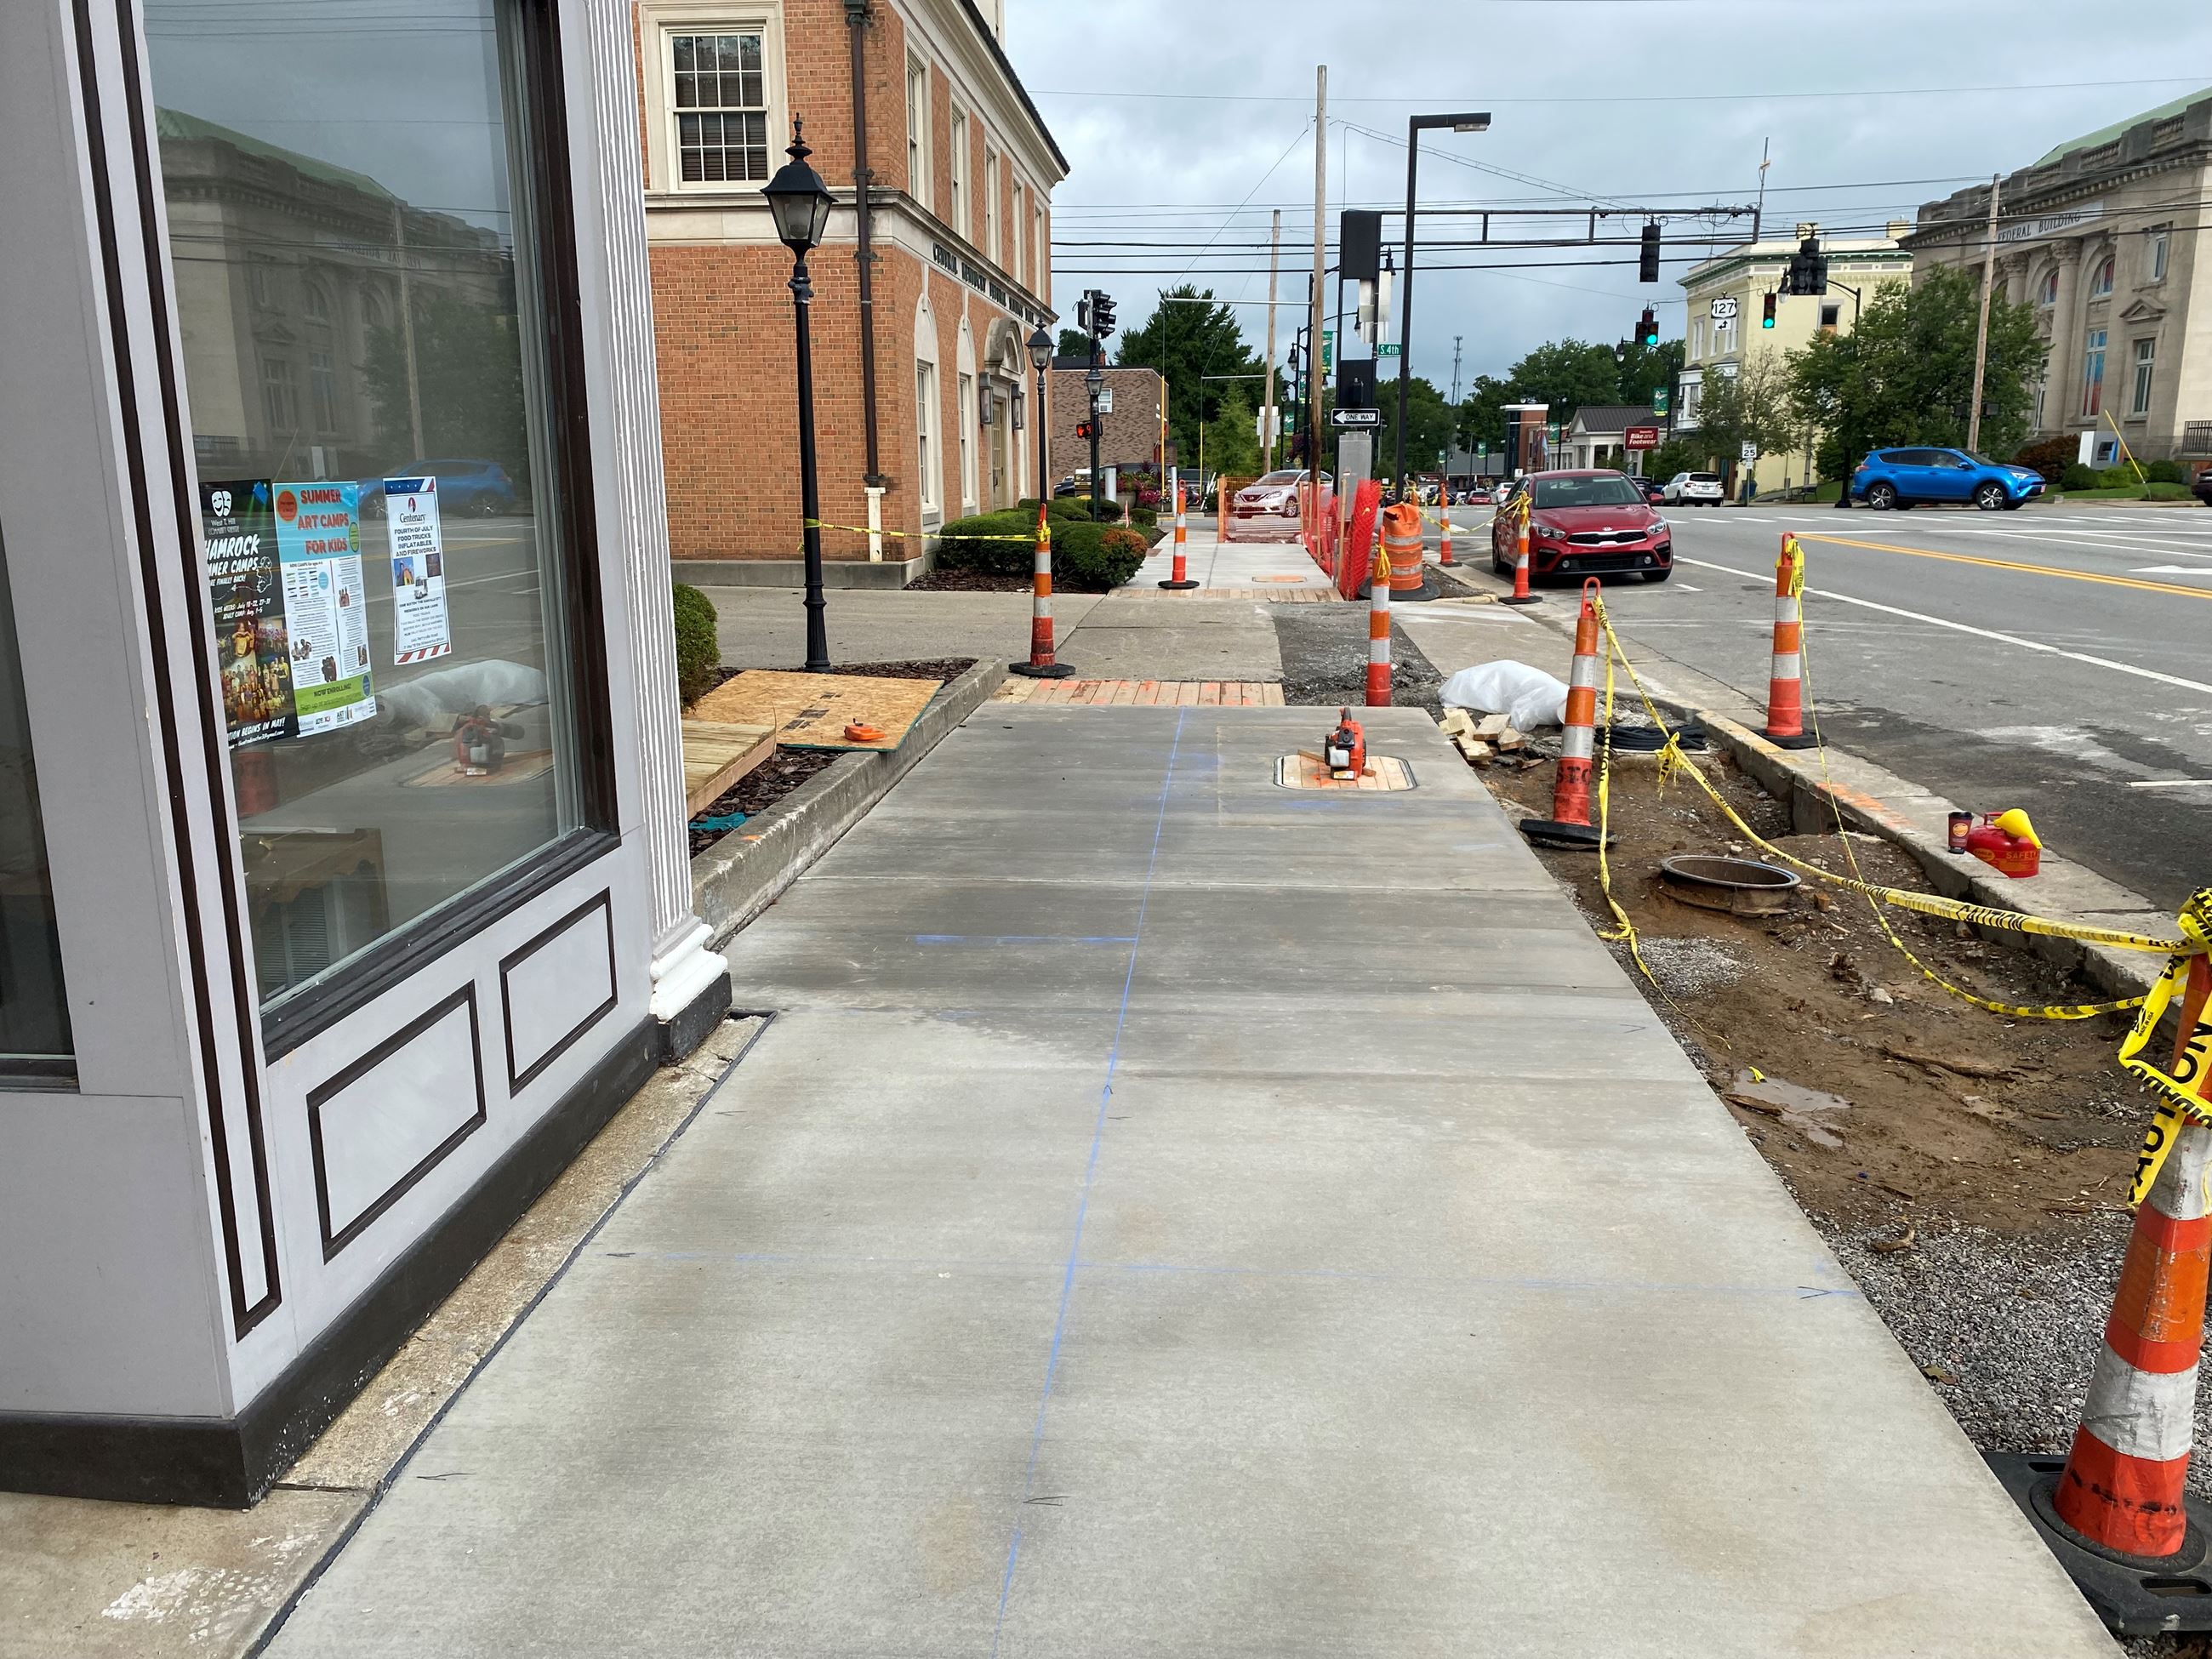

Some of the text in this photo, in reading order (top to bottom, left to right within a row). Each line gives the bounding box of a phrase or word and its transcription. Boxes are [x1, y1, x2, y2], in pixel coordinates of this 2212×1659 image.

[1998, 211, 2081, 242] FEDERAL BUILDING
[1714, 303, 1734, 314] 127
[1387, 345, 1400, 355] 4th
[300, 489, 342, 505] SUMMER
[298, 512, 350, 531] ART CAMPS
[399, 513, 426, 524] Centenary
[204, 533, 260, 561] HAMROCK
[305, 538, 348, 556] FOR KIDS
[398, 540, 432, 550] INFLATABLES
[408, 546, 436, 556] FIREWORKS
[231, 556, 259, 574] CAMPS
[313, 689, 327, 698] NOW
[241, 722, 262, 737] BEGINS
[262, 721, 271, 731] IN
[271, 716, 286, 729] MAY!
[1956, 904, 2029, 932] CAUTION
